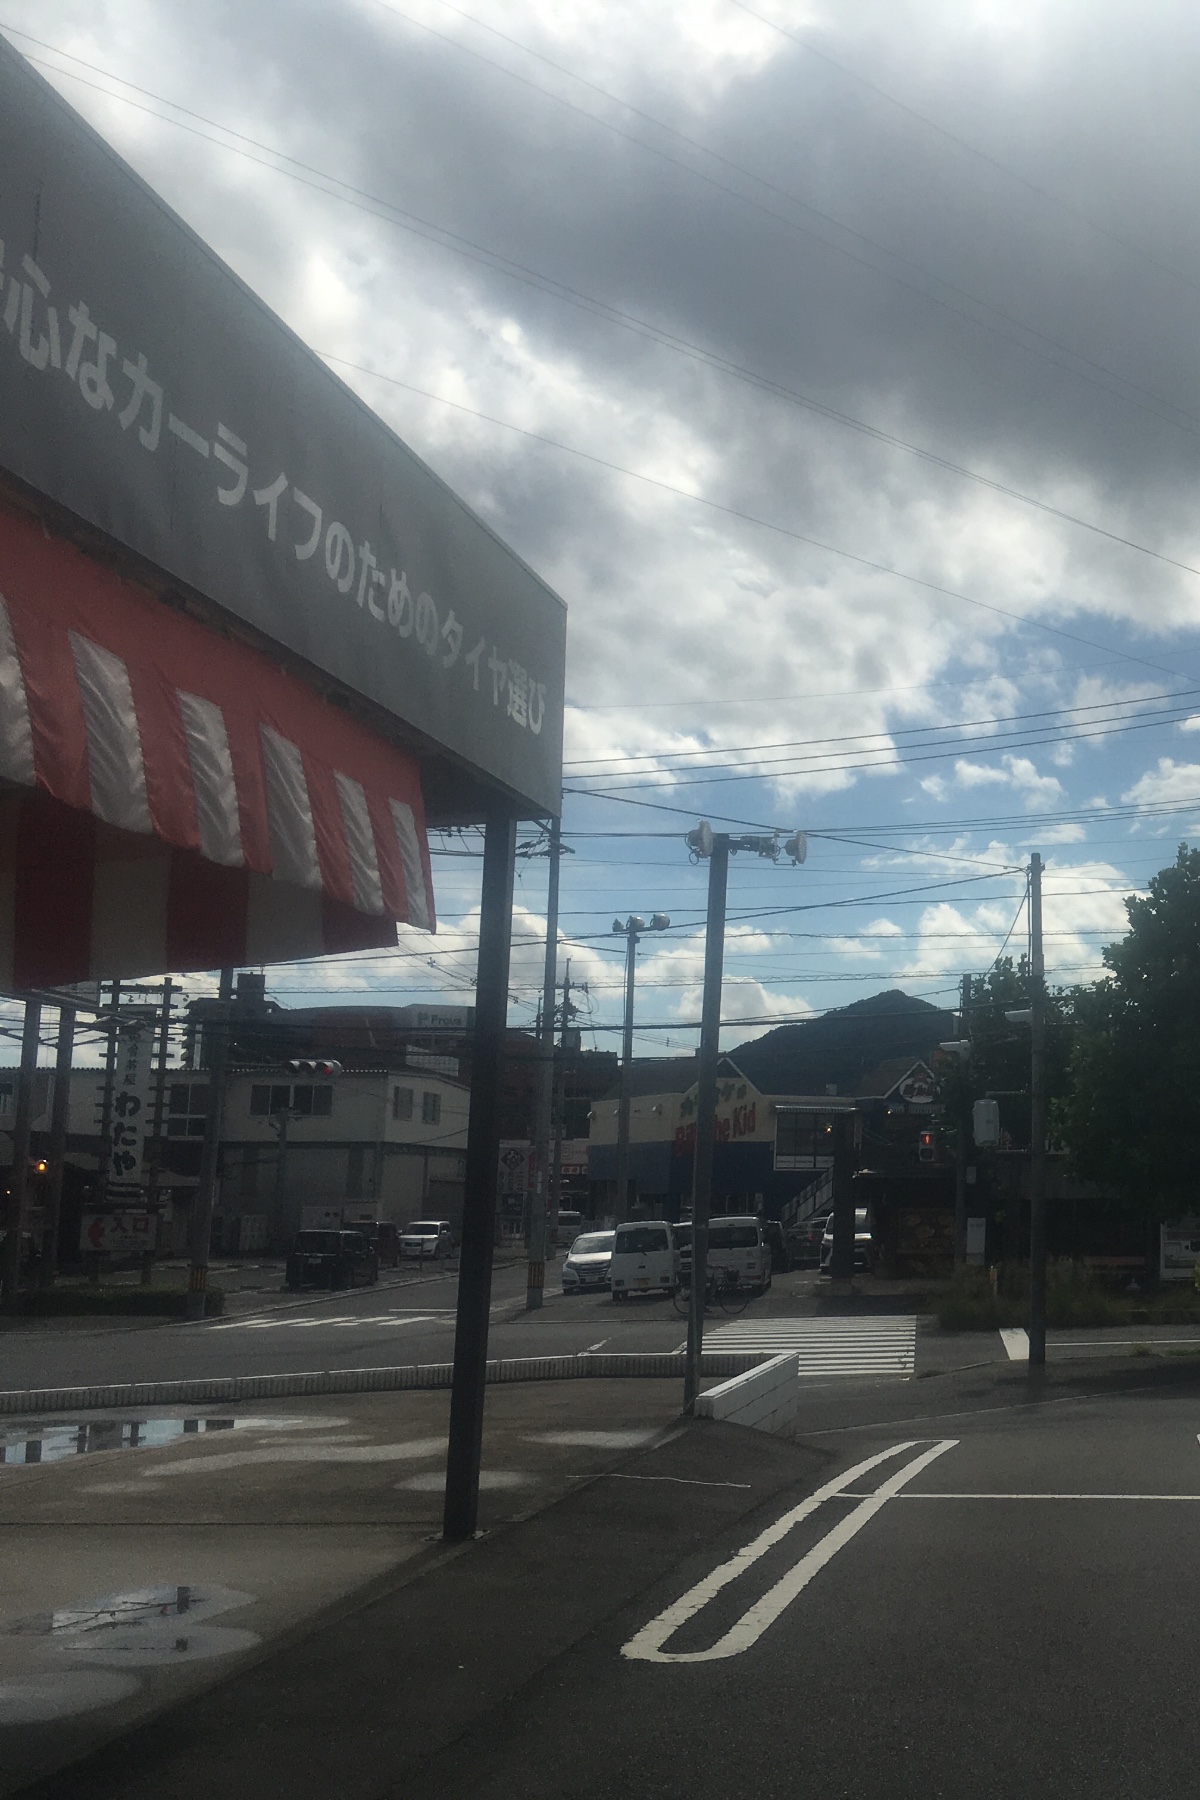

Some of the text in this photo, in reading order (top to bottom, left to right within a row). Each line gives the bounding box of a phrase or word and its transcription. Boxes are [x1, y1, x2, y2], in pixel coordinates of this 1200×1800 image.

[0, 239, 546, 735] 心なカーライフのためのタイヤ選び
[112, 1091, 141, 1176] わたや
[732, 1101, 756, 1138] Kid
[109, 1216, 149, 1234] 入口
